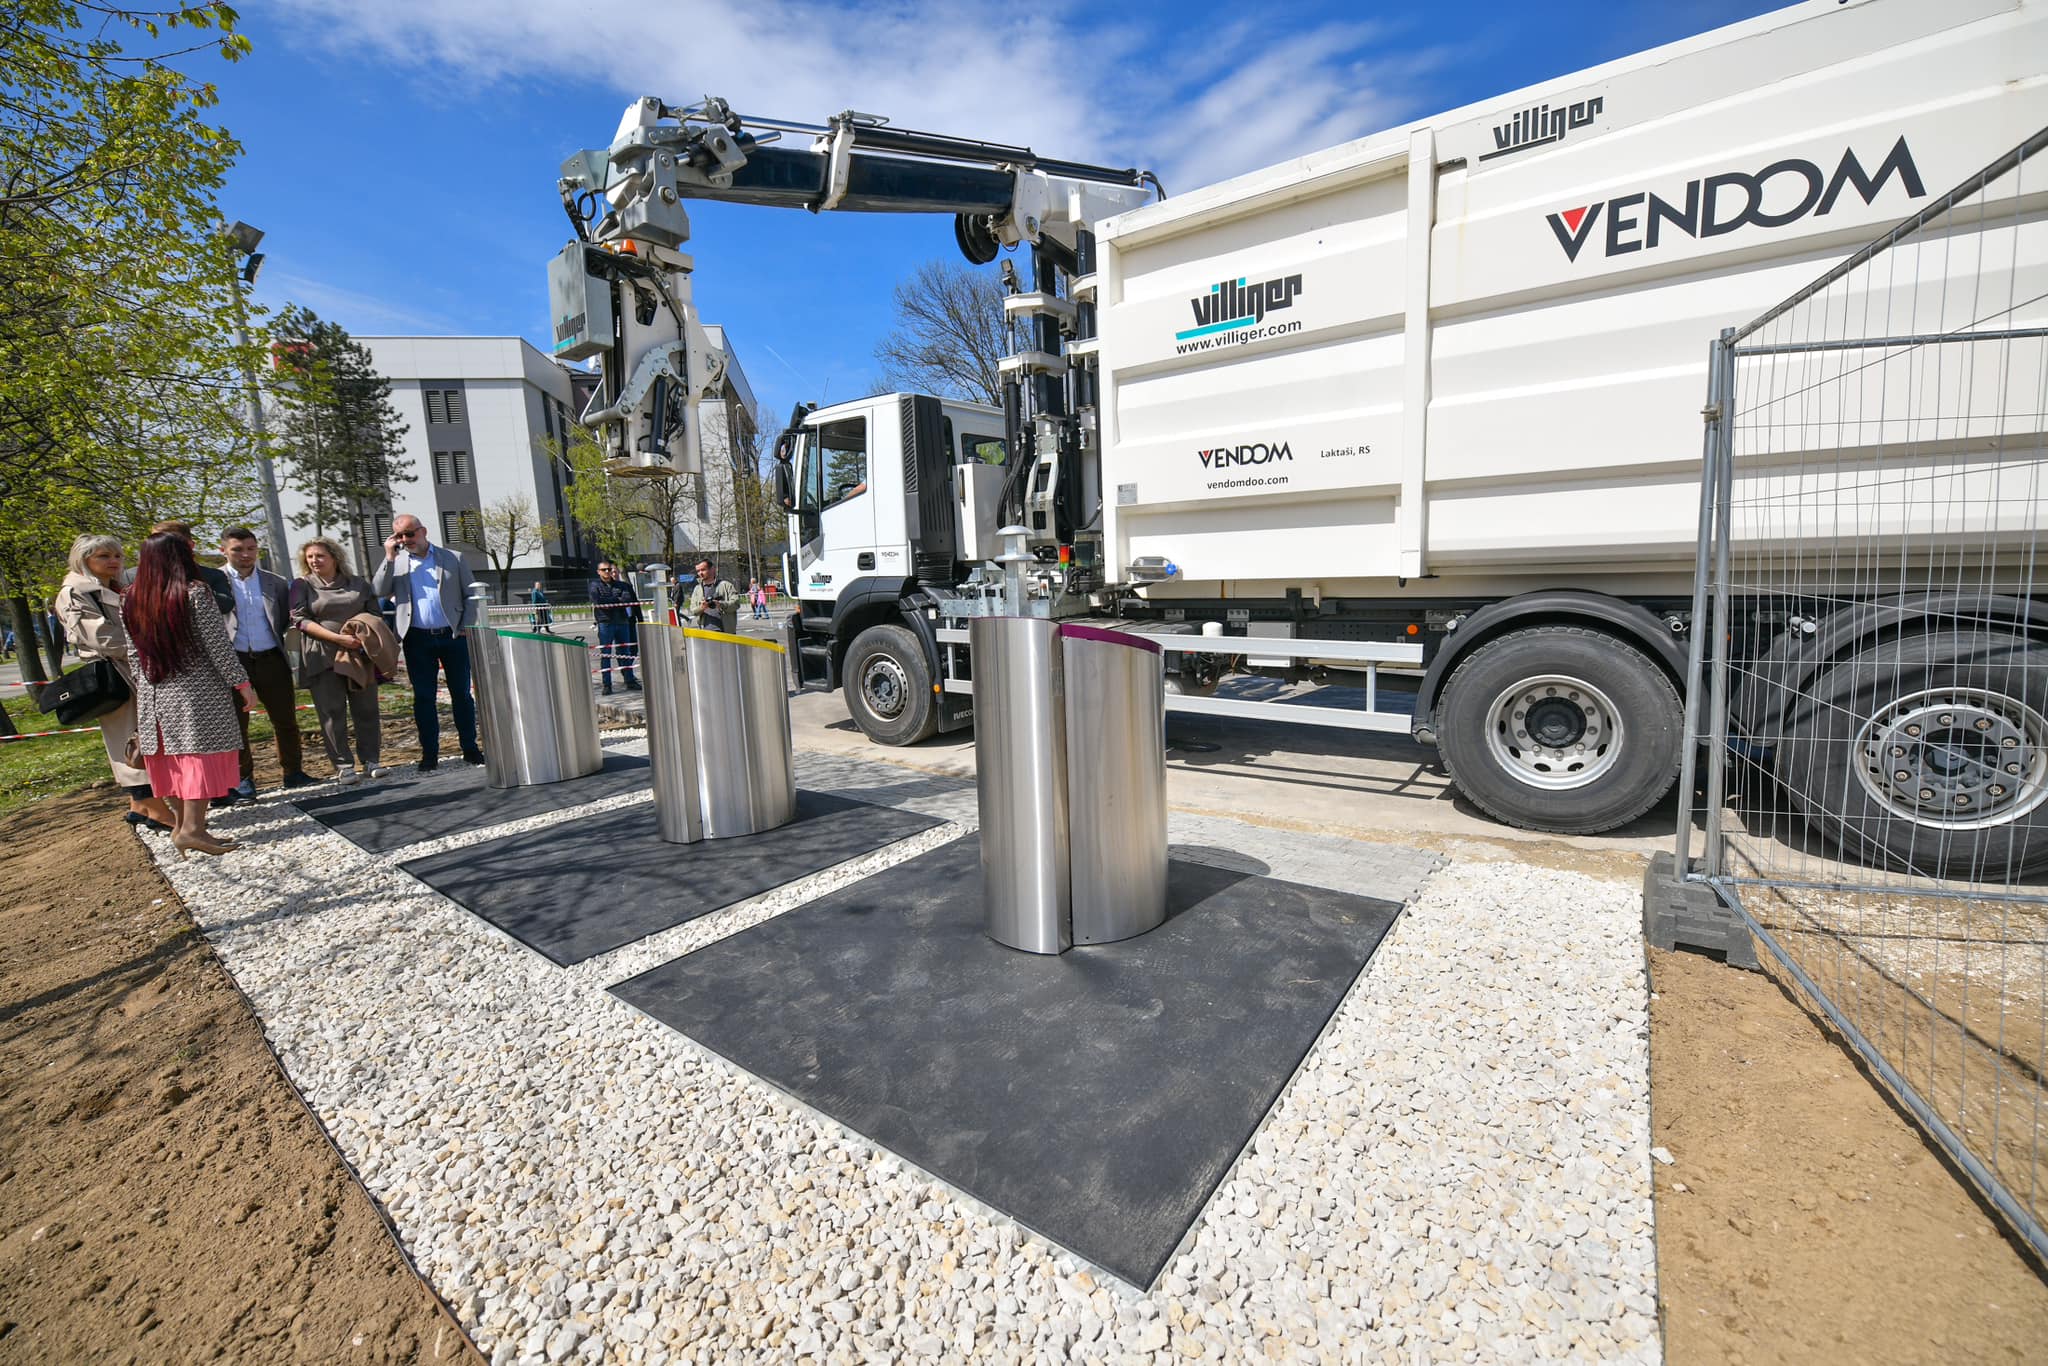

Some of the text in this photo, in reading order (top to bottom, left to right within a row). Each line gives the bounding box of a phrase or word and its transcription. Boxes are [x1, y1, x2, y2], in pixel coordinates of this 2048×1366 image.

[1493, 96, 1604, 149] villiger
[1545, 134, 1927, 264] VENDOM
[1191, 273, 1303, 326] villiger
[1176, 320, 1302, 354] www.villiger.com
[1198, 441, 1294, 469] VENDOM
[1320, 445, 1371, 459] Laktaši, RS
[1206, 474, 1289, 490] vendomdoo.com
[953, 709, 974, 721] IVECO
